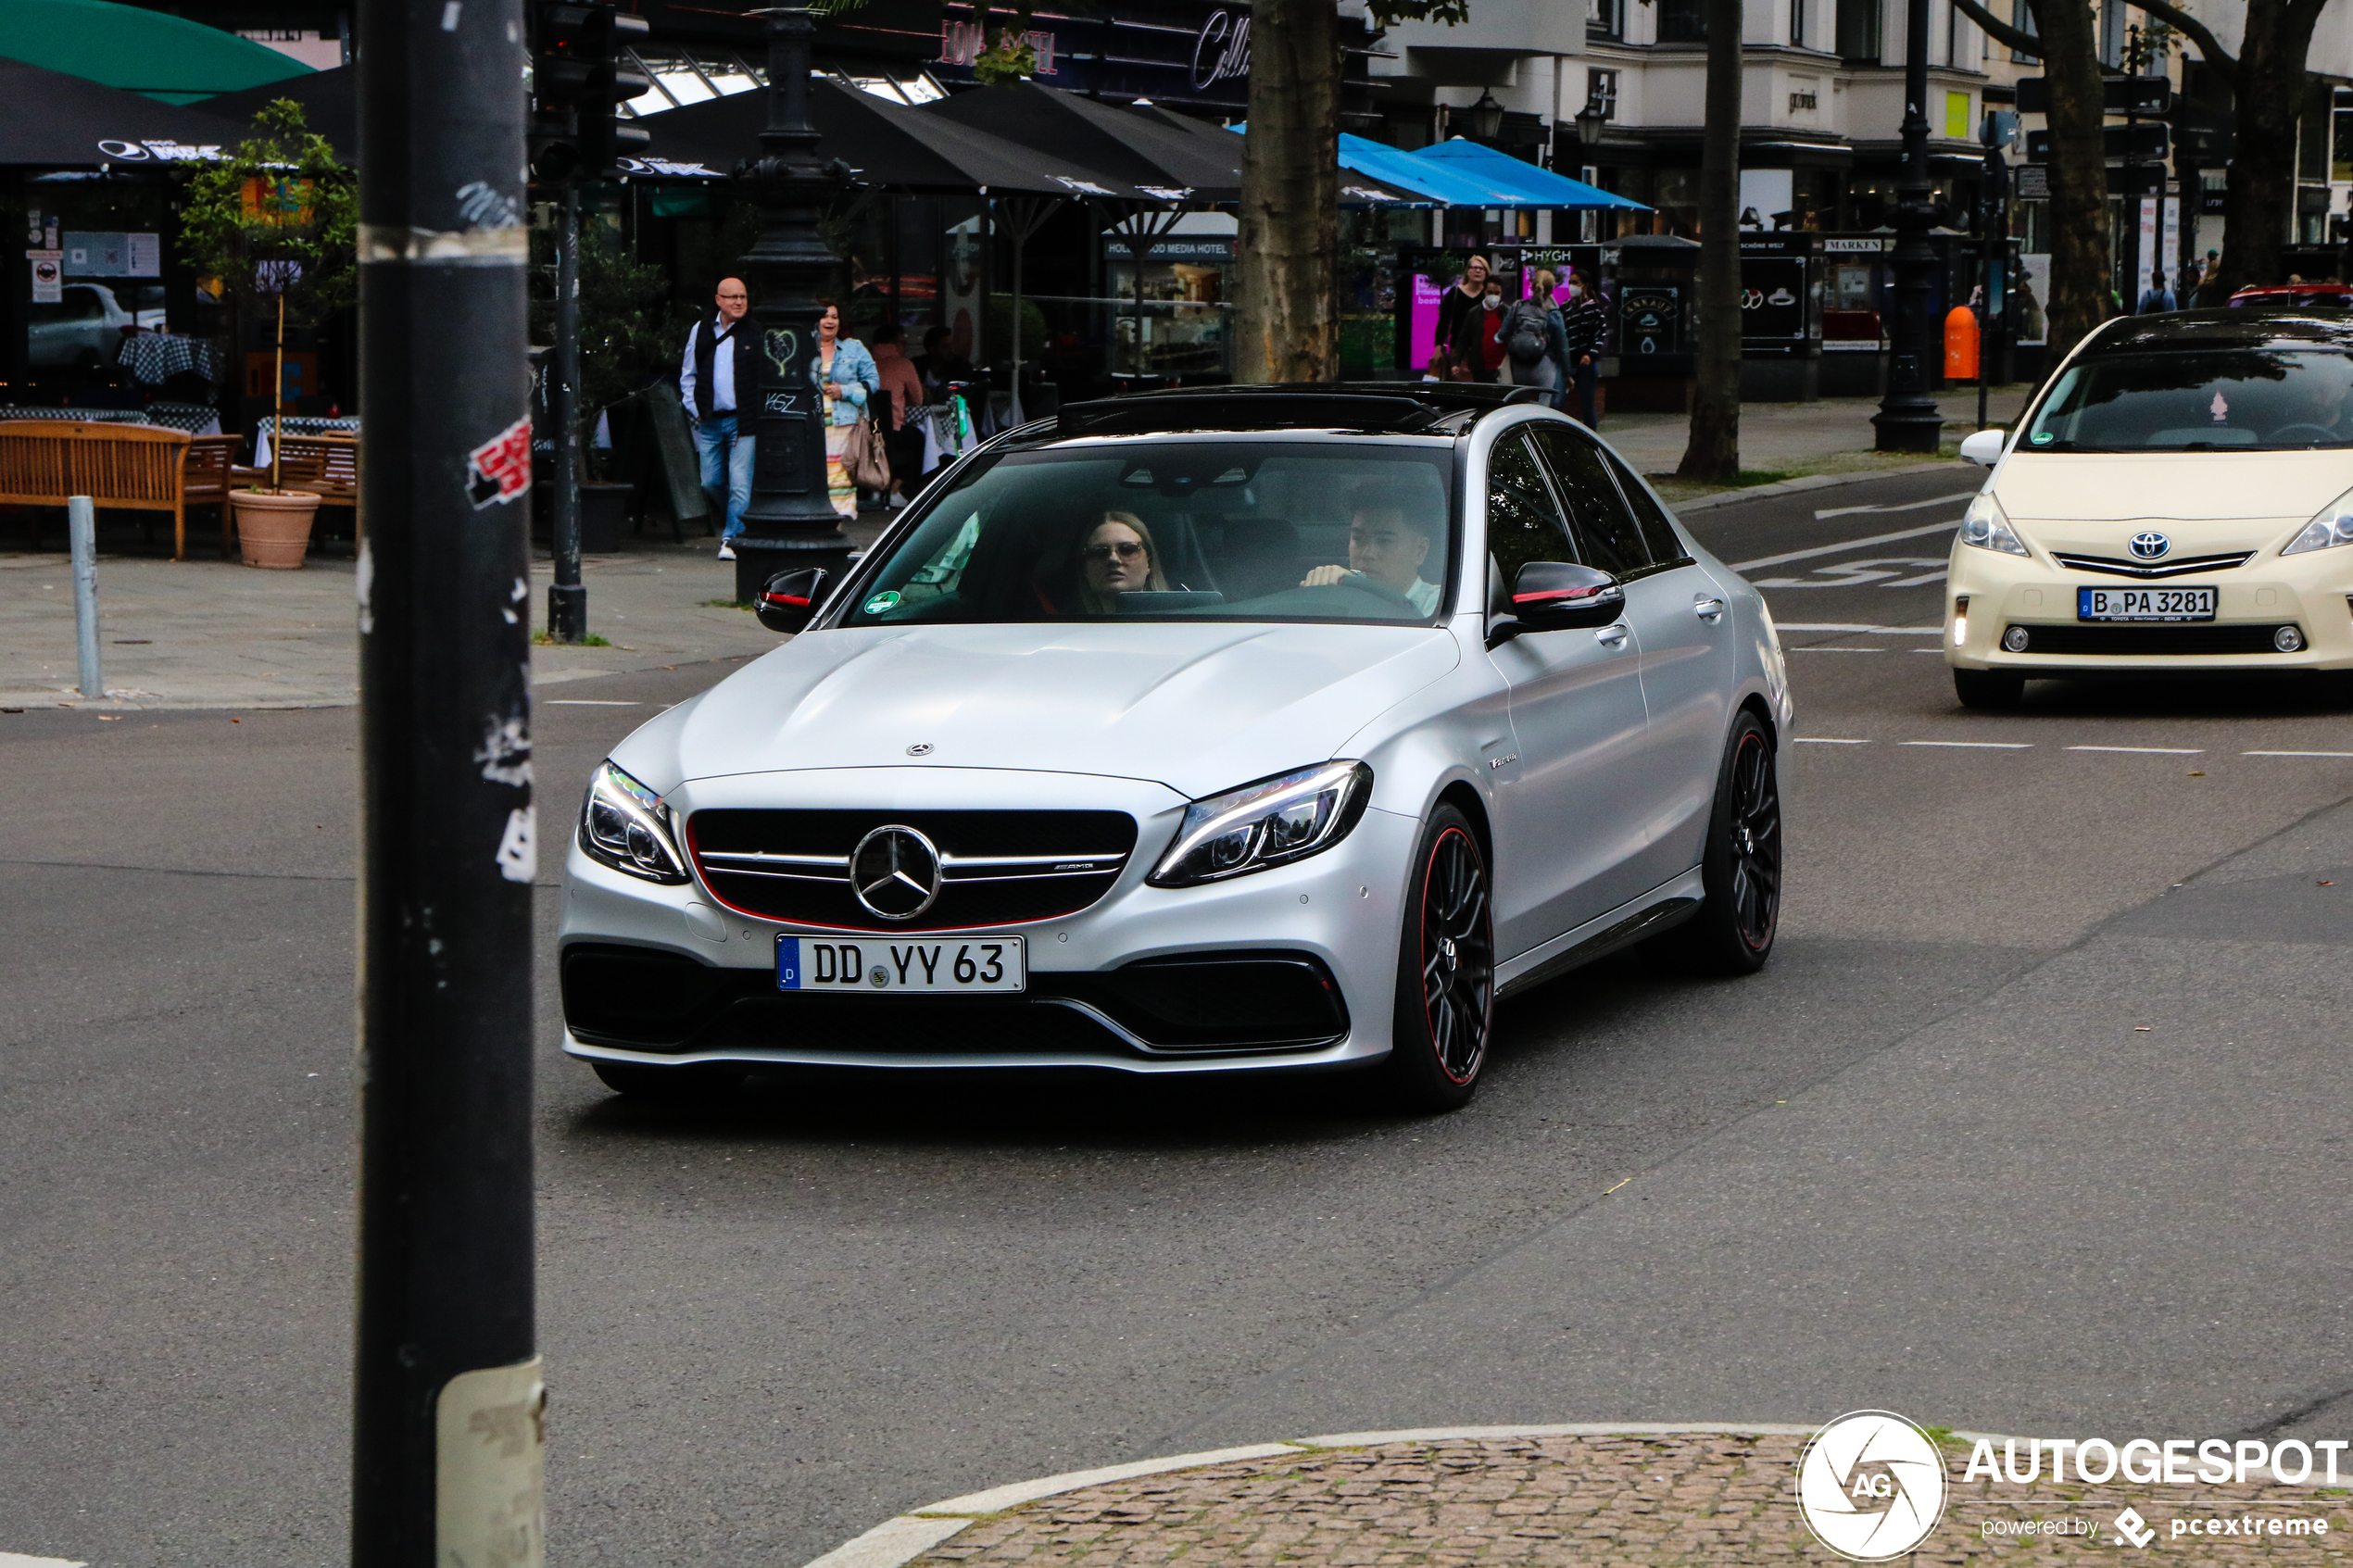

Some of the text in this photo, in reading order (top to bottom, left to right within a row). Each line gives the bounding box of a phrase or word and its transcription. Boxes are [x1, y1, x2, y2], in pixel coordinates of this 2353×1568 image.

[1167, 244, 1196, 254] MEDIA
[1198, 245, 1228, 255] HOTEL
[2095, 593, 2108, 613] B
[2124, 593, 2151, 613] PA
[2157, 593, 2211, 613] 3281
[785, 943, 1004, 985] D DD YY 63
